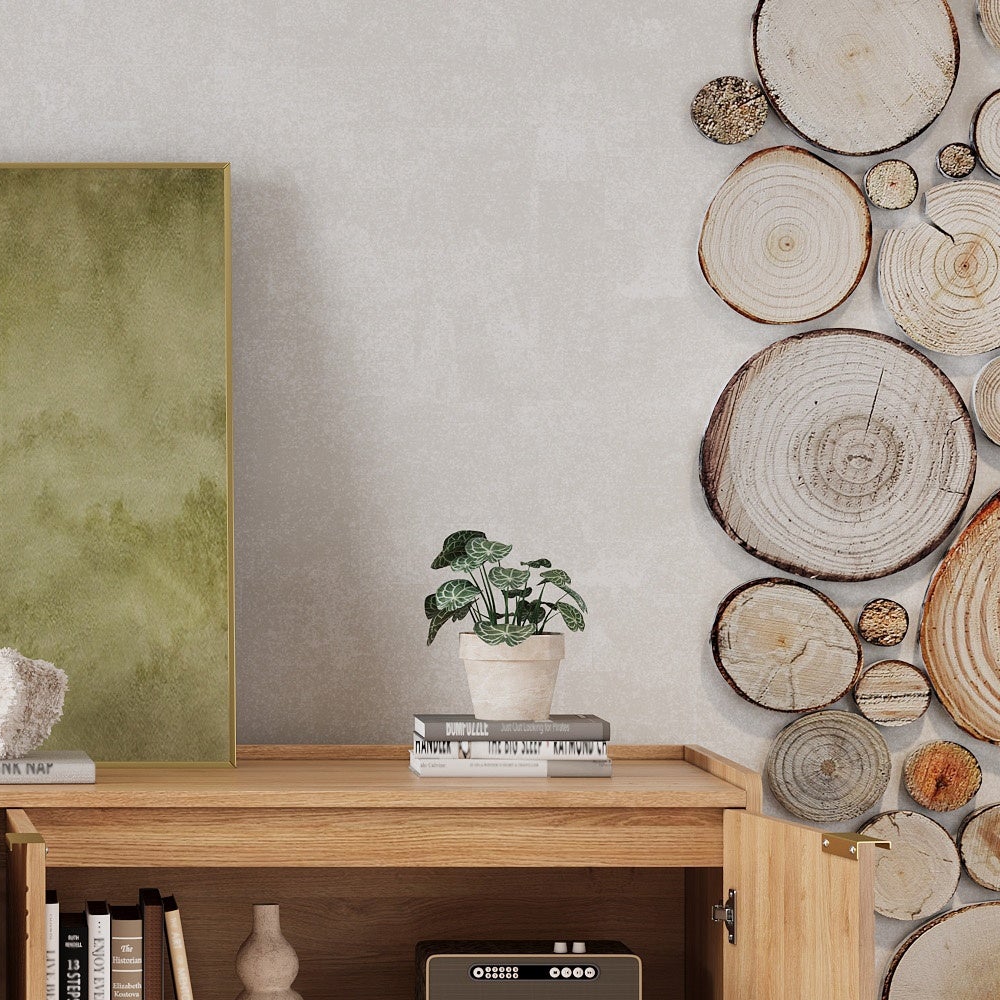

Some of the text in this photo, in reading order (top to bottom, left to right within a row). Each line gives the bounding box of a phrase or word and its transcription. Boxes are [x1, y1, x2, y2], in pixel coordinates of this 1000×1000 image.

[488, 741, 501, 754] THE
[26, 763, 53, 775] NAP
[120, 944, 134, 953] The
[92, 938, 104, 974] ENJOY
[113, 956, 142, 964] Historian
[67, 960, 80, 970] 13
[113, 982, 142, 990] Elizabeth
[114, 990, 140, 998] Kostova
